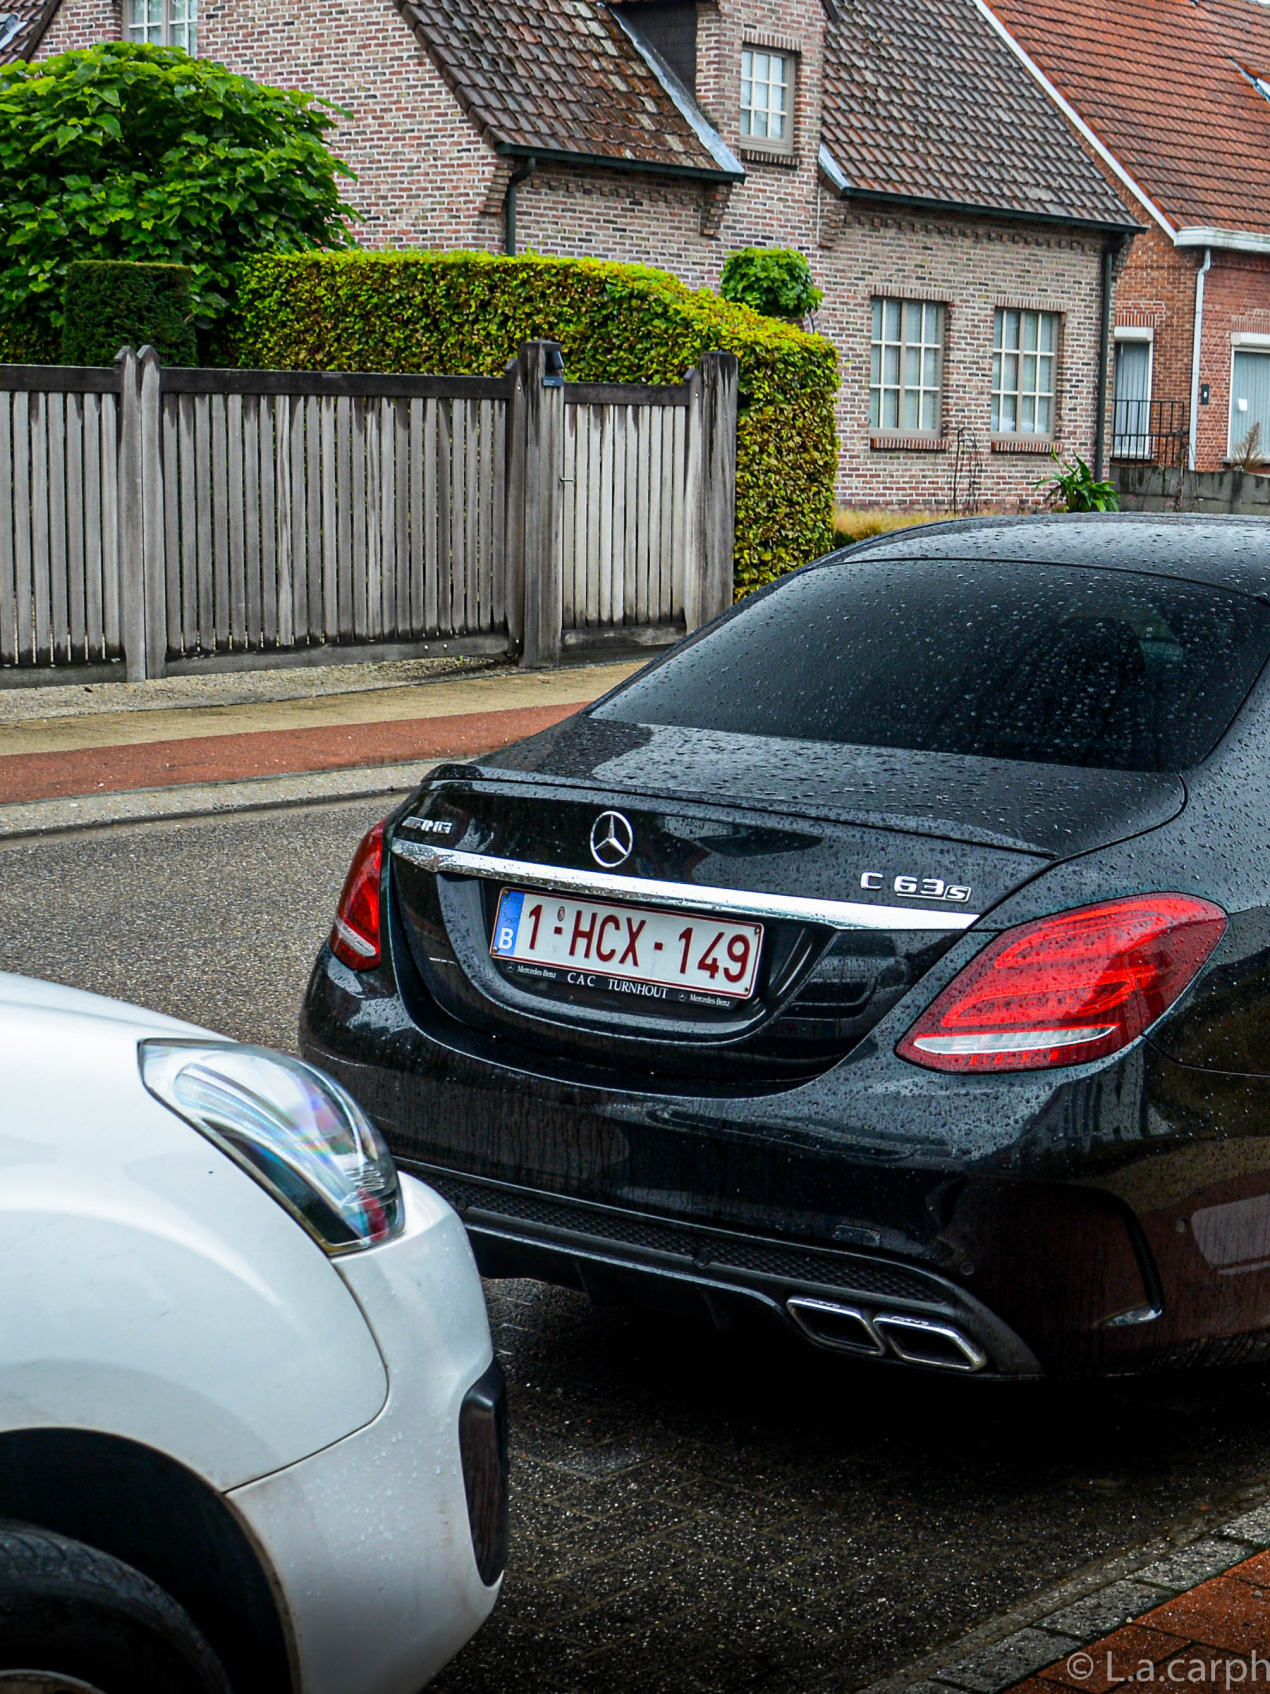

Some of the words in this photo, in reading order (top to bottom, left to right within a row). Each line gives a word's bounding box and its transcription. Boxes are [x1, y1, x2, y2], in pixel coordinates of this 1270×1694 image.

[860, 872, 884, 890] C
[498, 927, 515, 950] B
[528, 904, 751, 983] 1-HCX-149
[608, 978, 669, 999] TURNHOUT
